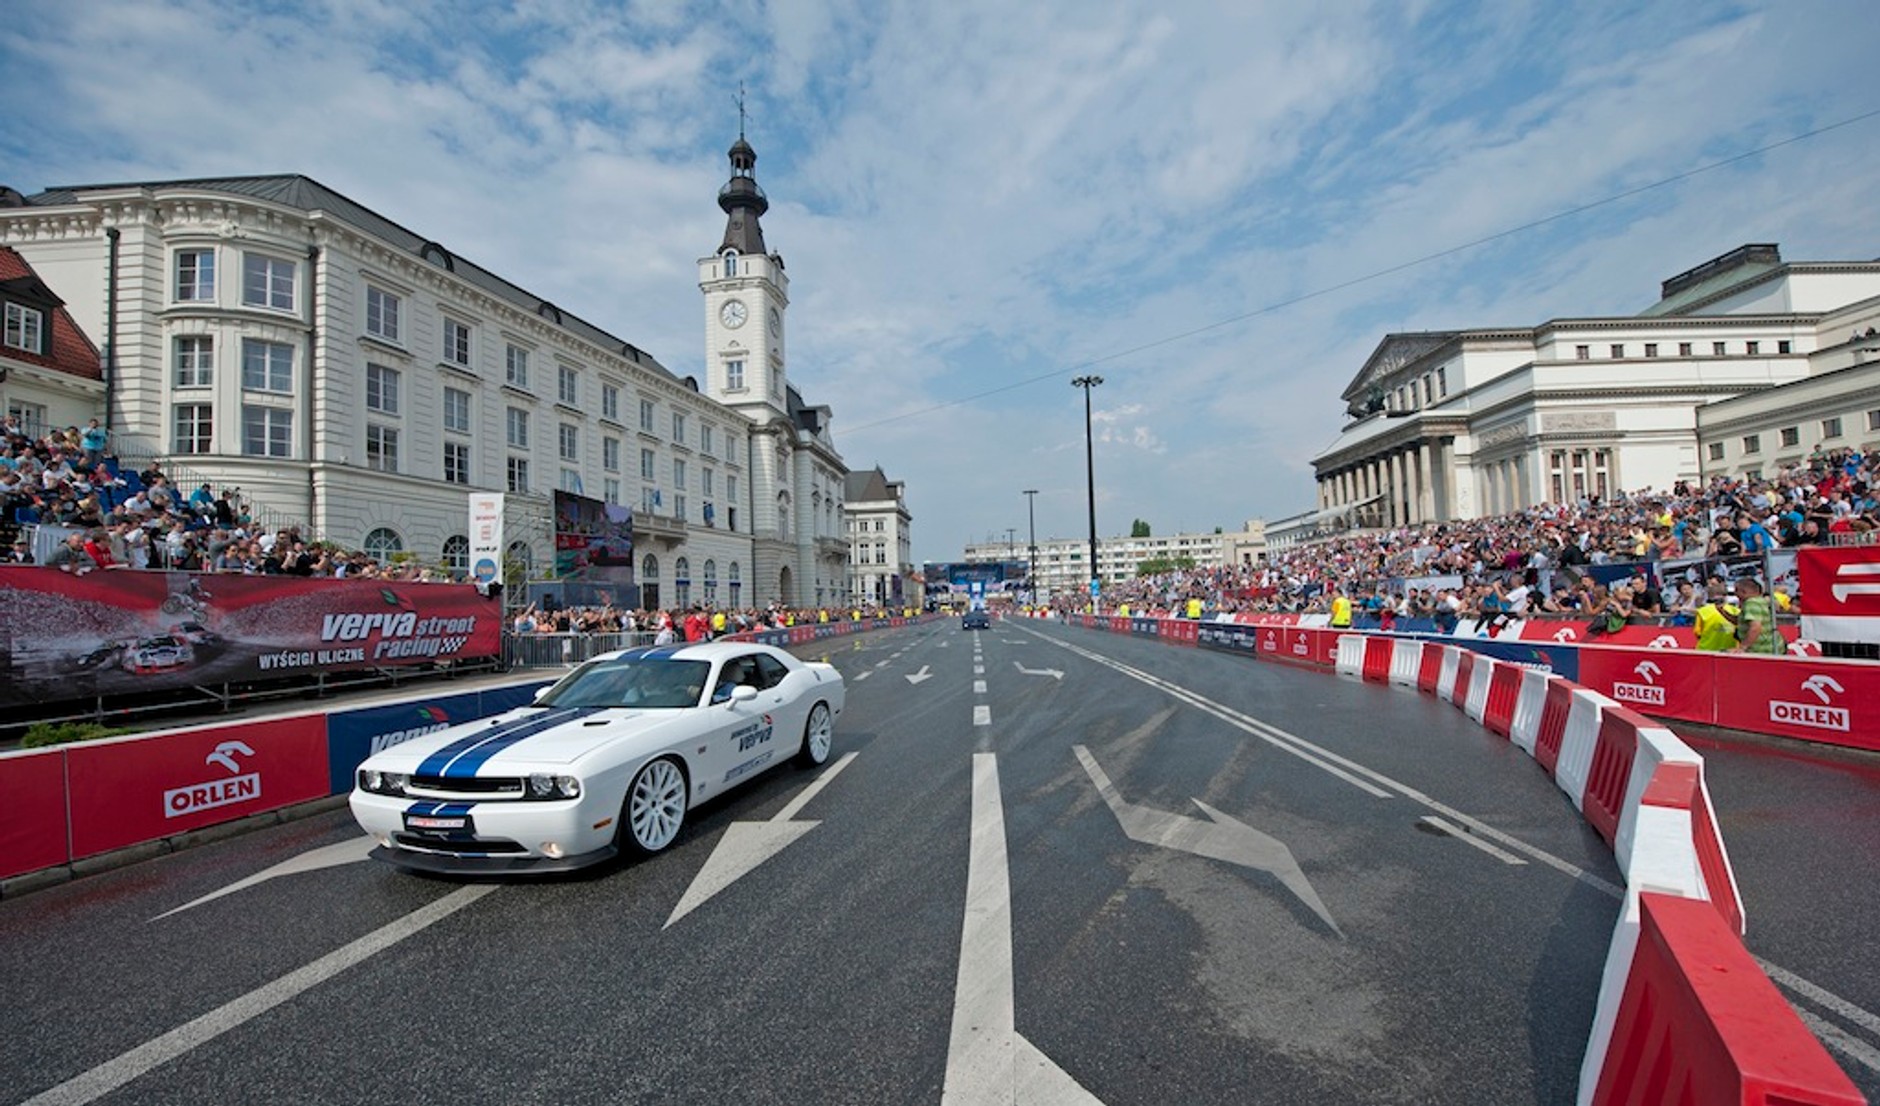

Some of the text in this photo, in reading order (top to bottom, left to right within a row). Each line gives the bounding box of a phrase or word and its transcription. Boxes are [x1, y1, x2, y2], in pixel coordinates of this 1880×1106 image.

[321, 612, 475, 640] verva street
[374, 634, 441, 659] racing
[259, 648, 364, 669] WYŚCIGI ULICZNE
[1617, 686, 1661, 701] ORLEN
[1774, 705, 1843, 727] ORLEN
[170, 778, 255, 811] ORLEN
